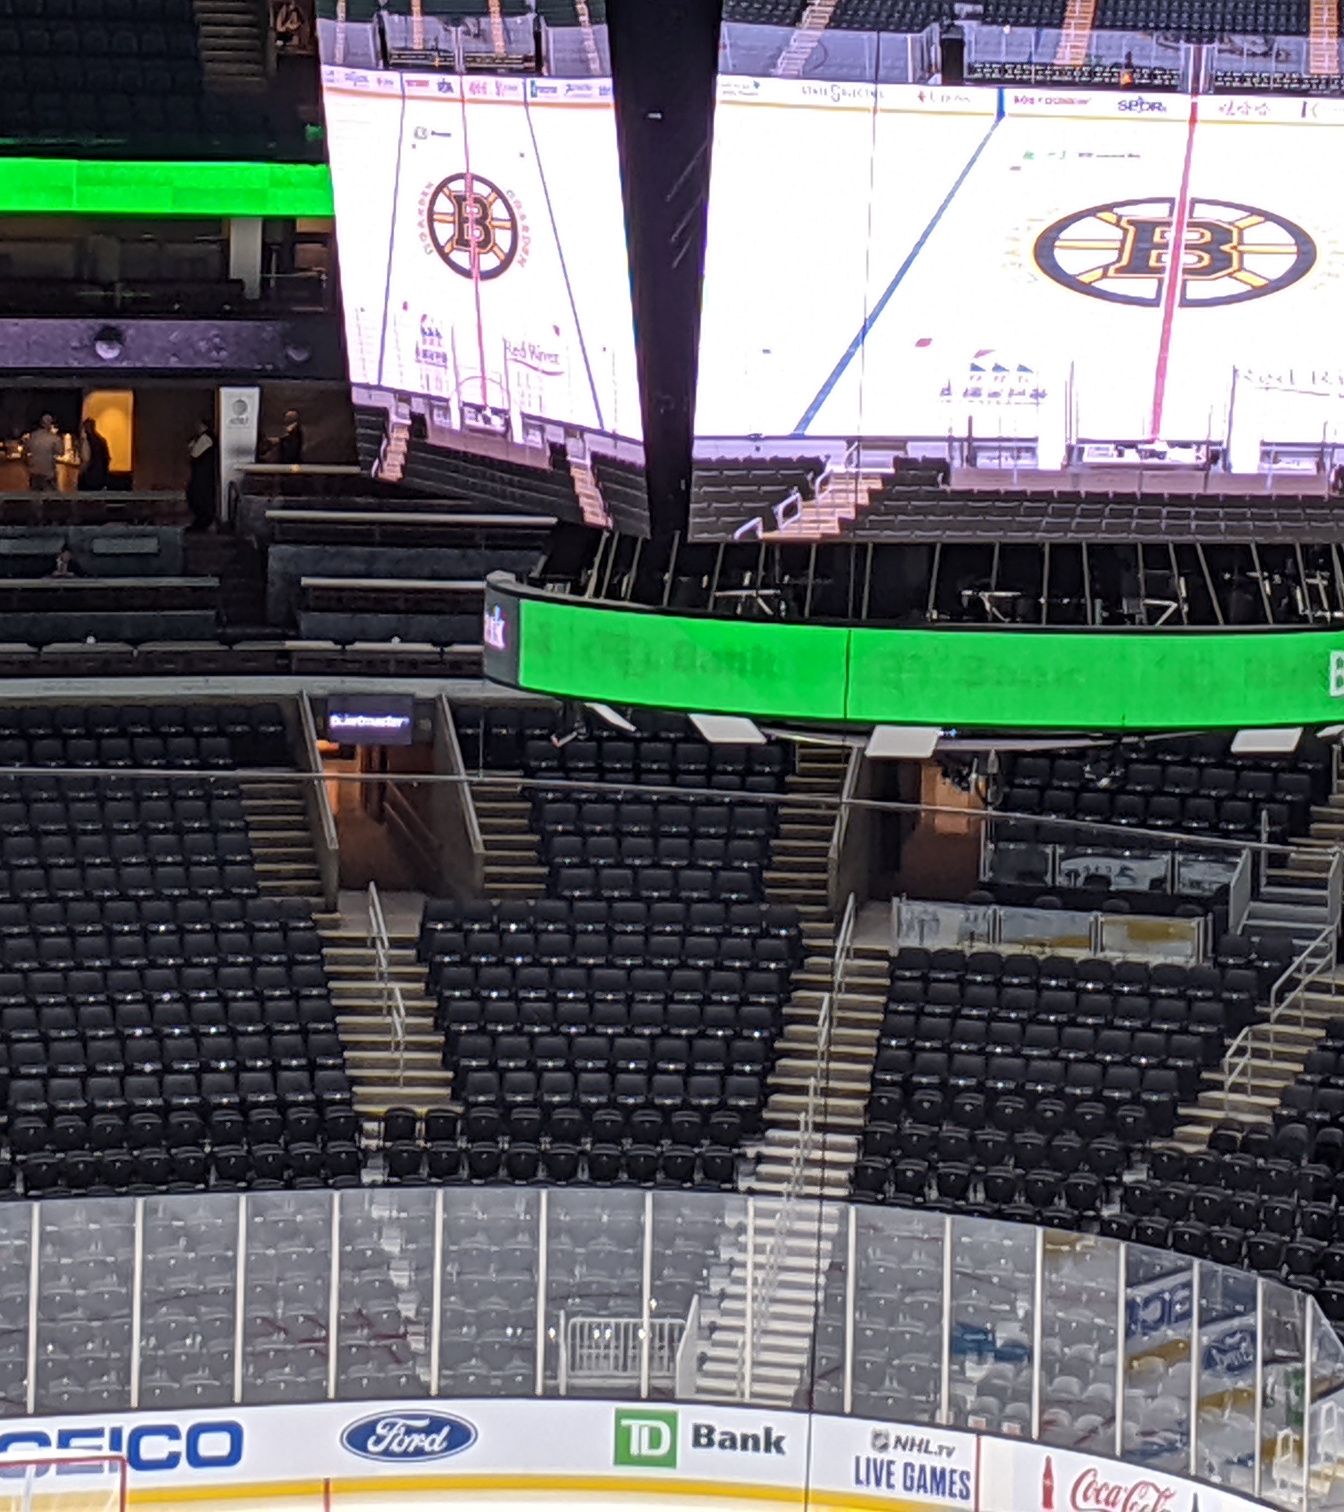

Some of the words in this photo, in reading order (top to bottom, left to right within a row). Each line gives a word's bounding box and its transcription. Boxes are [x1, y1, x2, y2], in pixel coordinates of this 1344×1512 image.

[366, 1415, 453, 1455] Ford
[620, 1419, 671, 1459] TD
[692, 1423, 787, 1456] Bank
[855, 1454, 900, 1486] LIVE
[902, 1460, 972, 1503] GAMES
